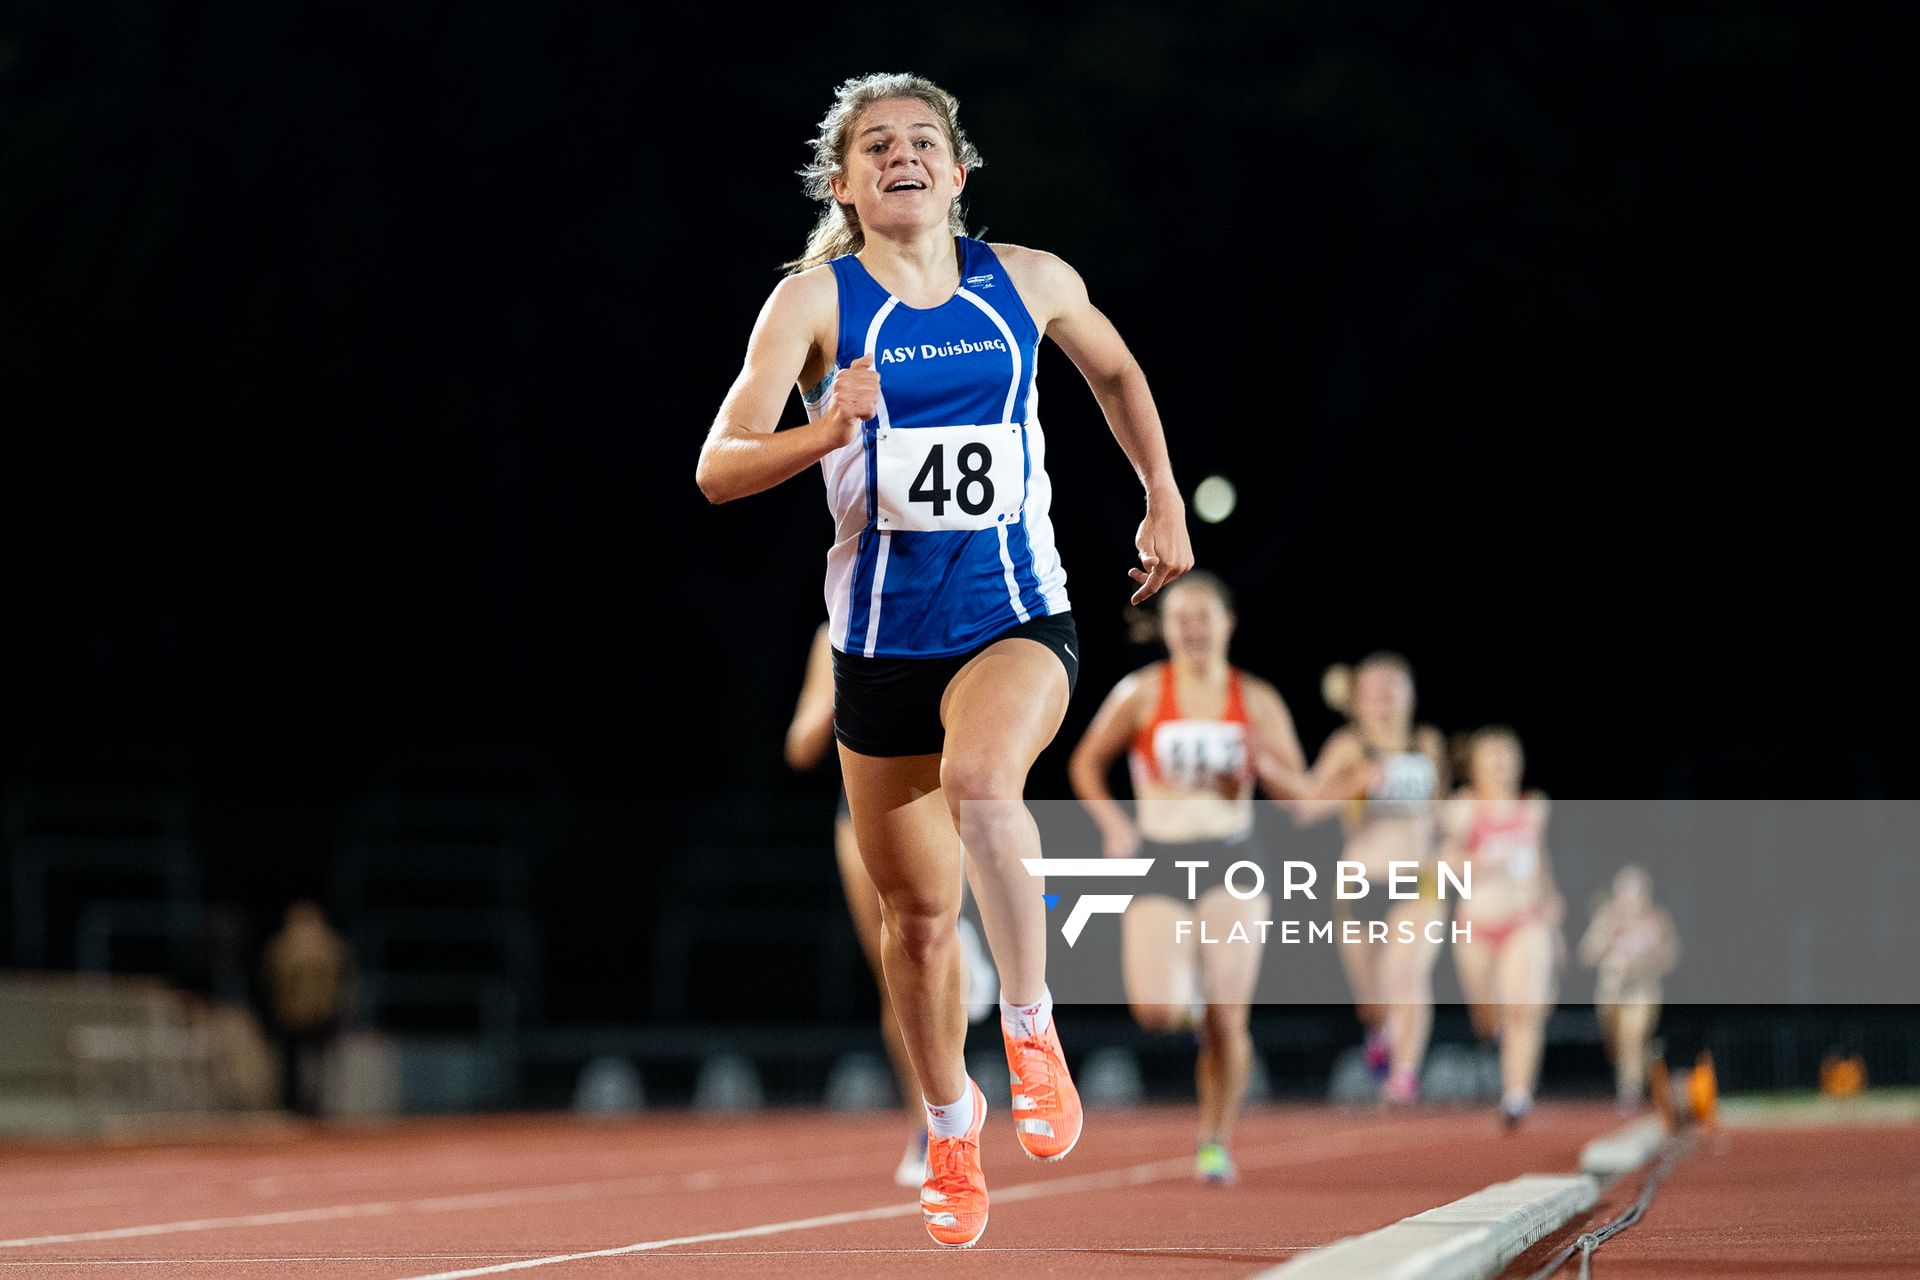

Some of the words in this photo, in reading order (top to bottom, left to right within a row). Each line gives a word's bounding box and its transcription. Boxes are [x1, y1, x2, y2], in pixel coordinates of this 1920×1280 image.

[880, 345, 917, 365] ASV
[920, 338, 1007, 360] Duisburg
[909, 442, 995, 517] 48
